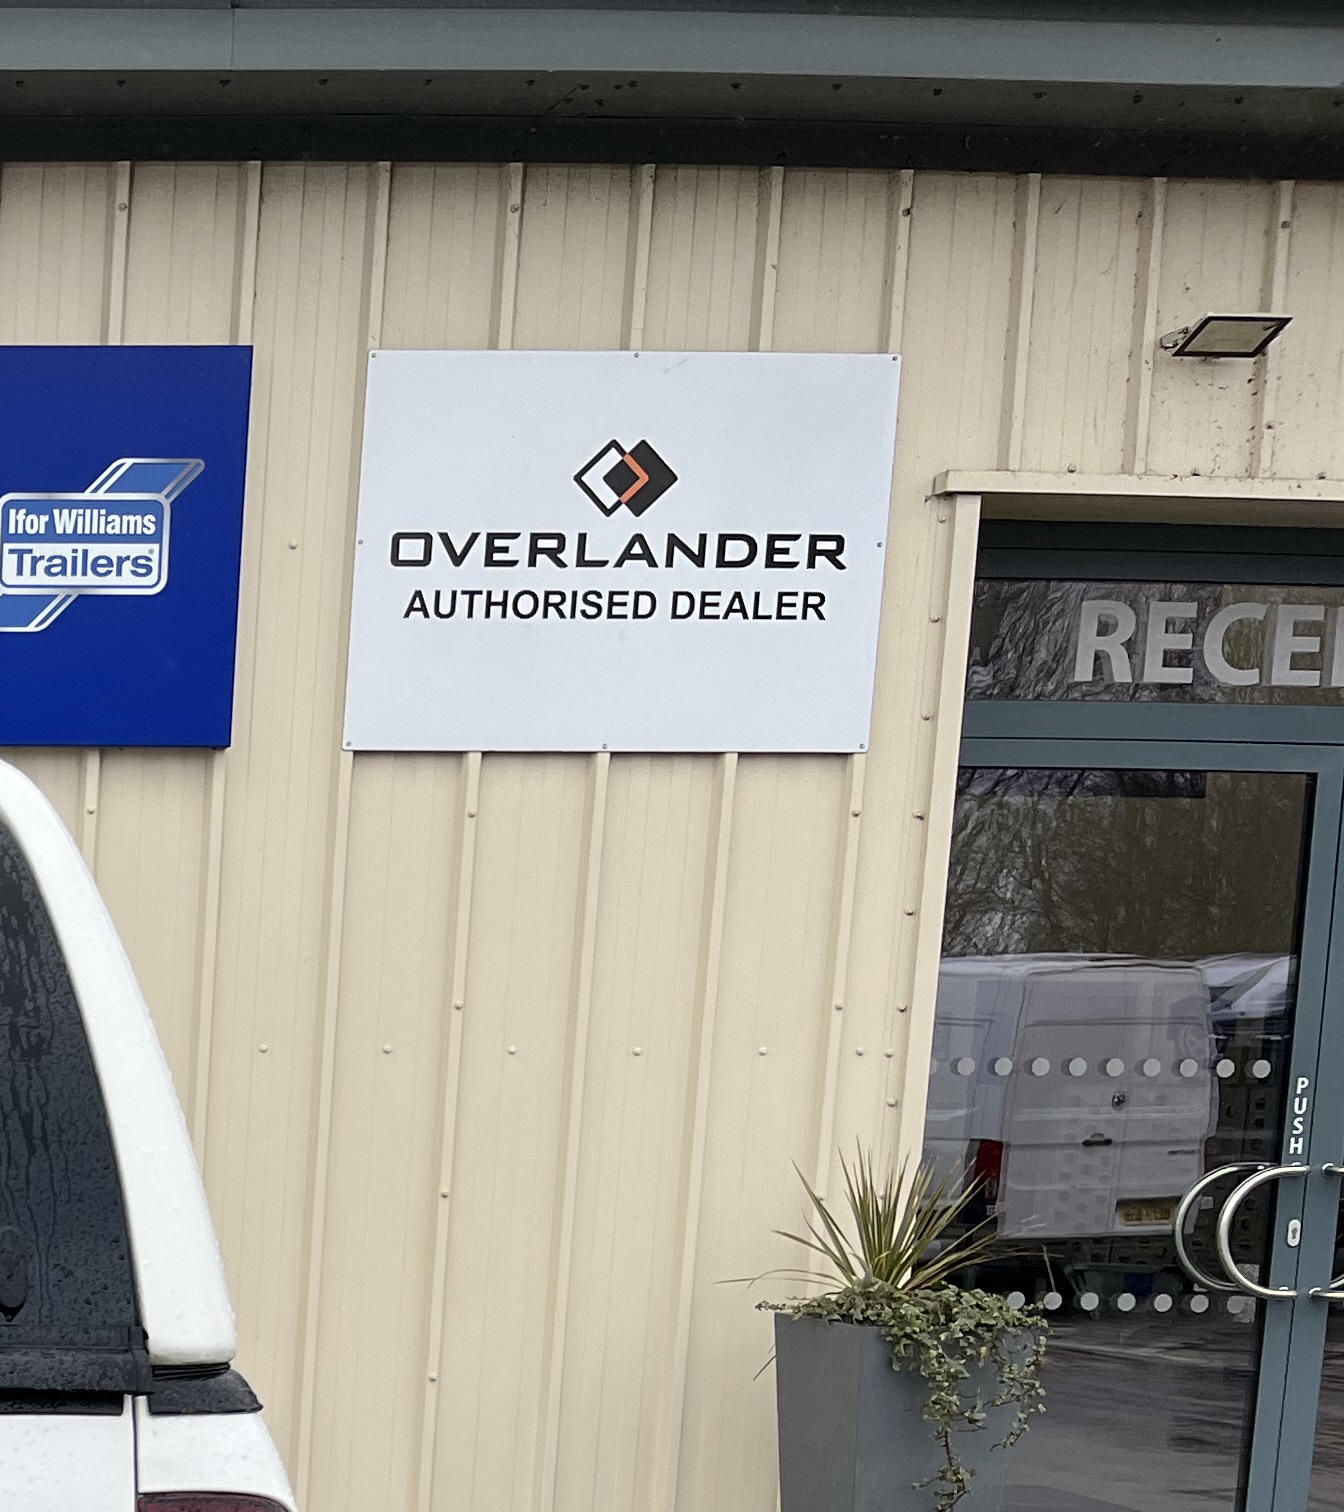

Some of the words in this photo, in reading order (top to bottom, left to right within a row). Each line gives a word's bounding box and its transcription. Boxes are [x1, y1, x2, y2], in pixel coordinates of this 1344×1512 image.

[8, 508, 49, 534] Ifor
[53, 508, 156, 535] Williams
[8, 548, 154, 577] Trailers
[389, 531, 848, 570] OVERLANDER
[403, 589, 658, 620] AUTHORISED
[670, 591, 827, 621] DEALER
[1073, 599, 1344, 687] RECE
[1289, 1077, 1310, 1155] PUSH
